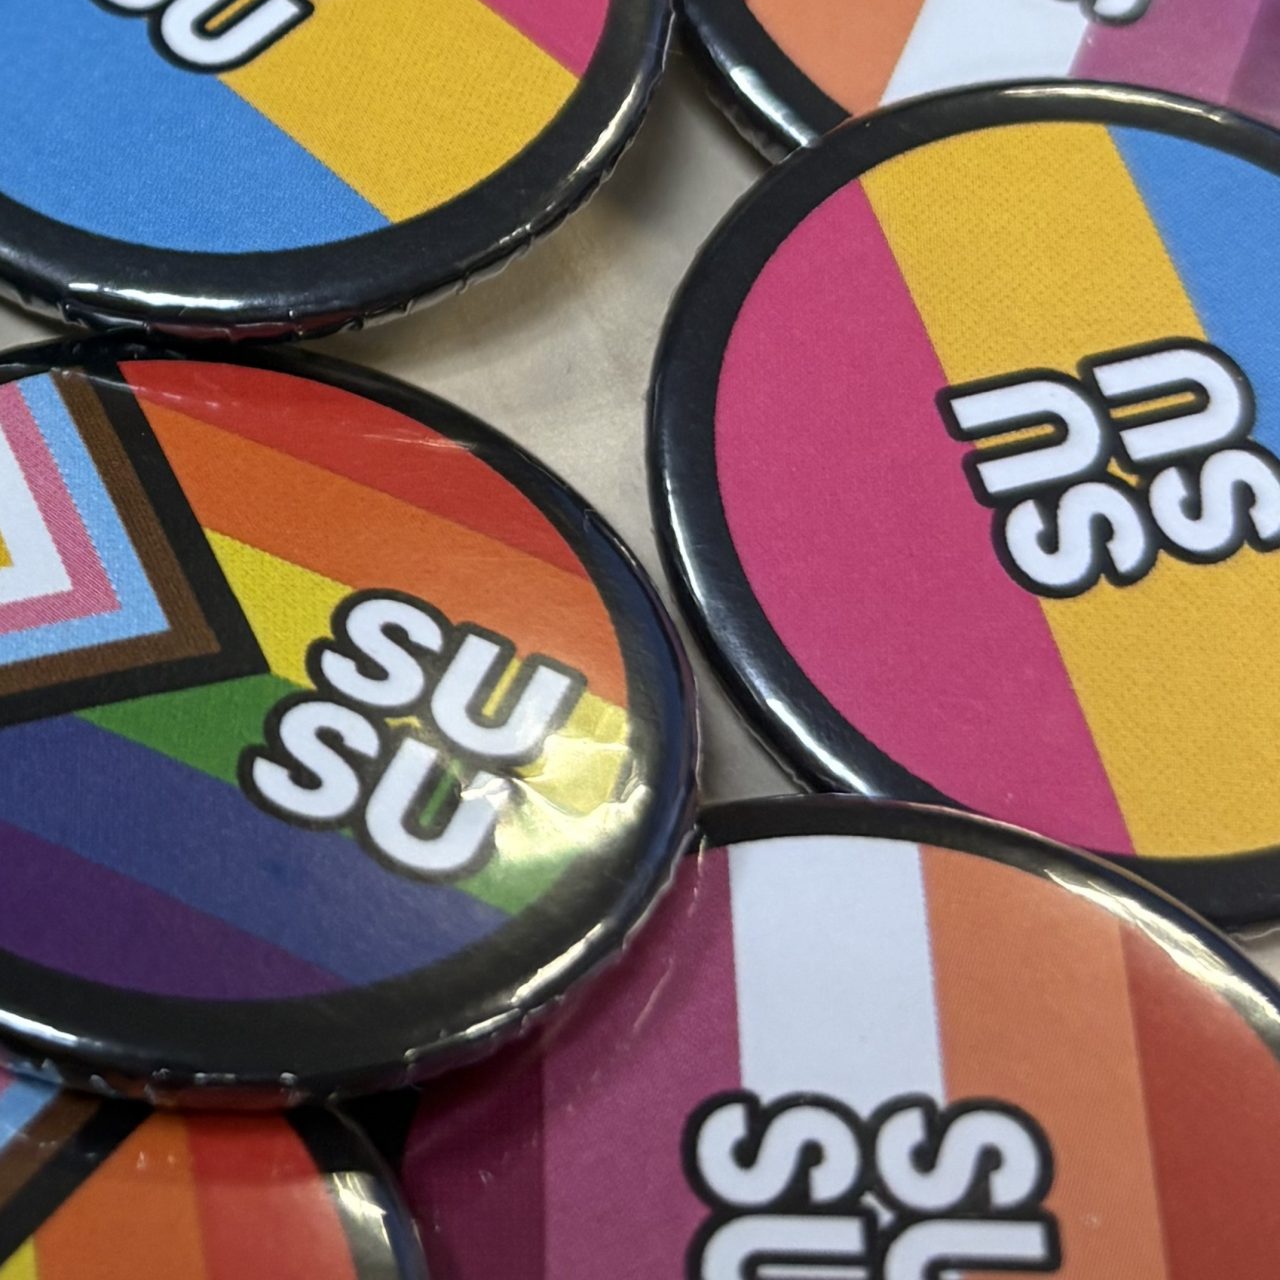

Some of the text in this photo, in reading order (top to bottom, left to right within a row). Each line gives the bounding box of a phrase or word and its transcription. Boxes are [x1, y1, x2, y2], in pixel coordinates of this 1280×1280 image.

[948, 377, 1148, 588] SU
[1090, 346, 1280, 554] SU
[320, 597, 574, 758] SU
[251, 699, 510, 872] SU
